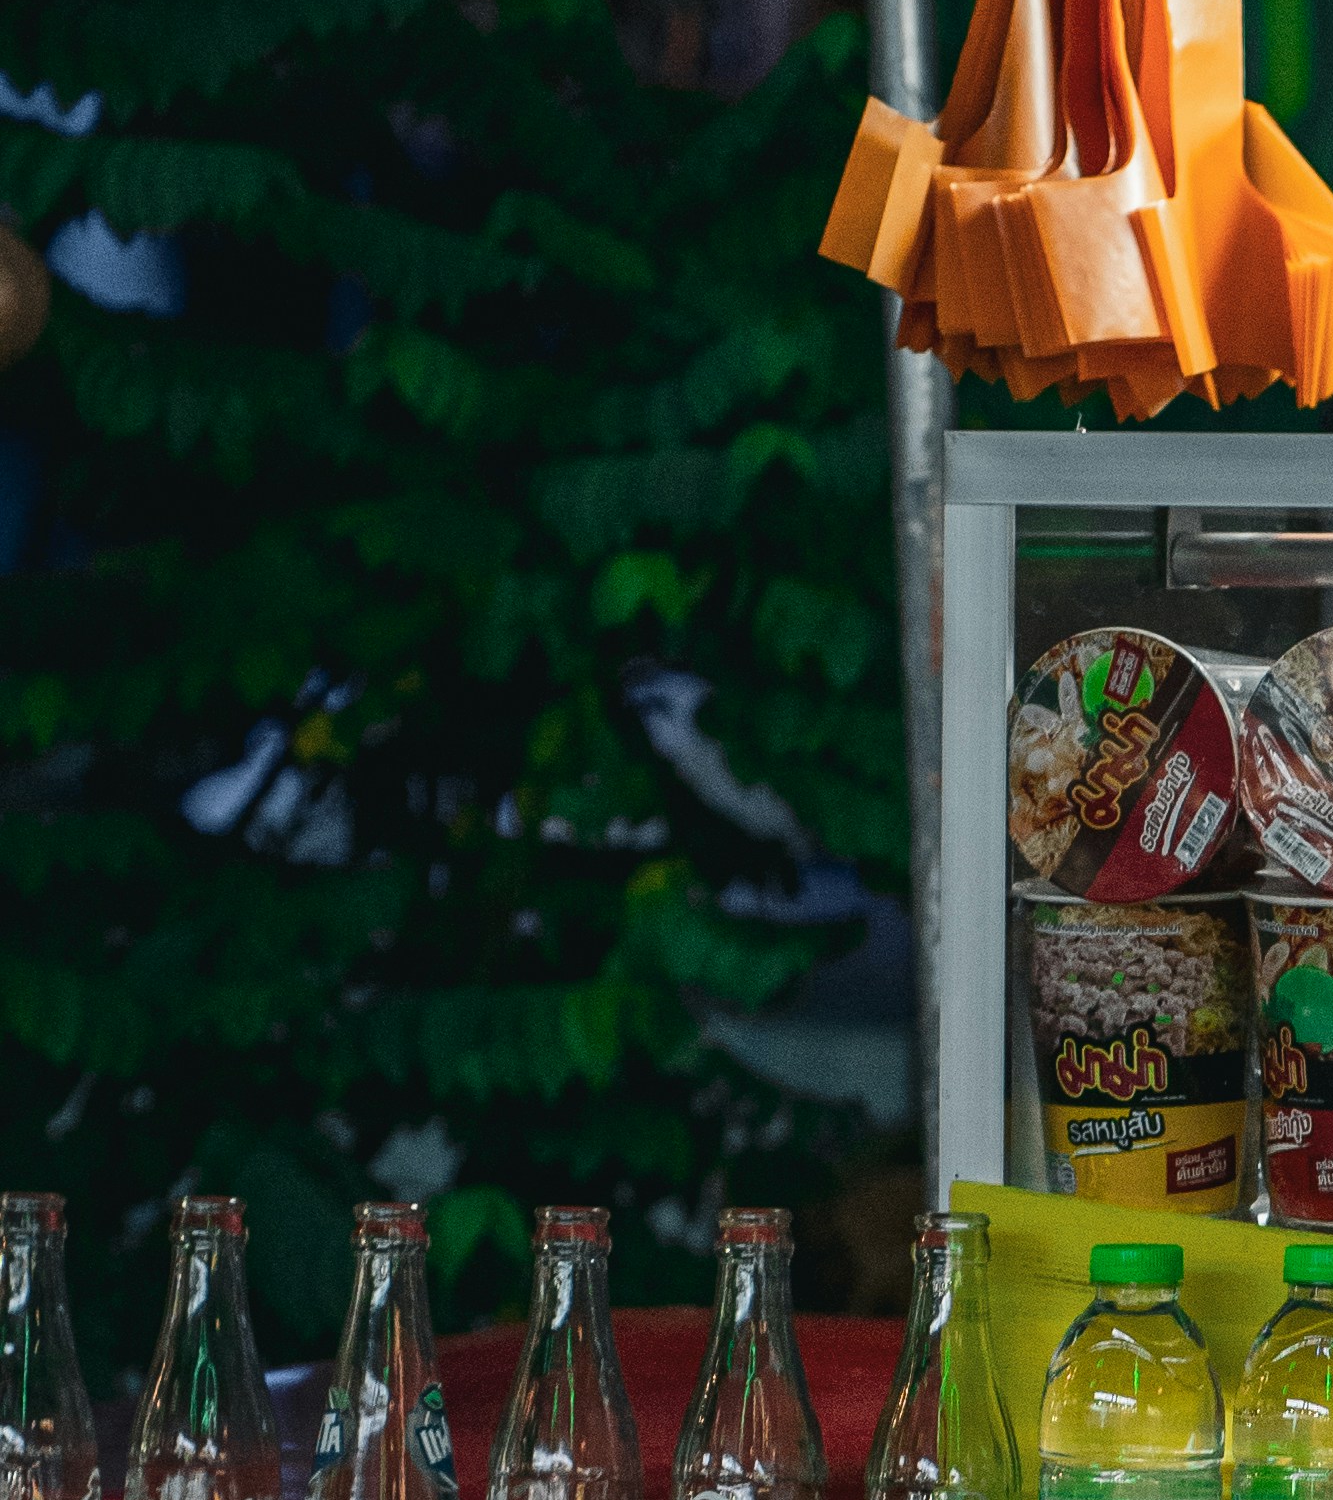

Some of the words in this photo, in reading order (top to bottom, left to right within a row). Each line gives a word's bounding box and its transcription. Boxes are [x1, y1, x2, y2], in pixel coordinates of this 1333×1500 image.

[1071, 711, 1160, 830] มาม่า
[1056, 1027, 1168, 1100] มาม่า
[1068, 1110, 1164, 1148] รสหมูสับ
